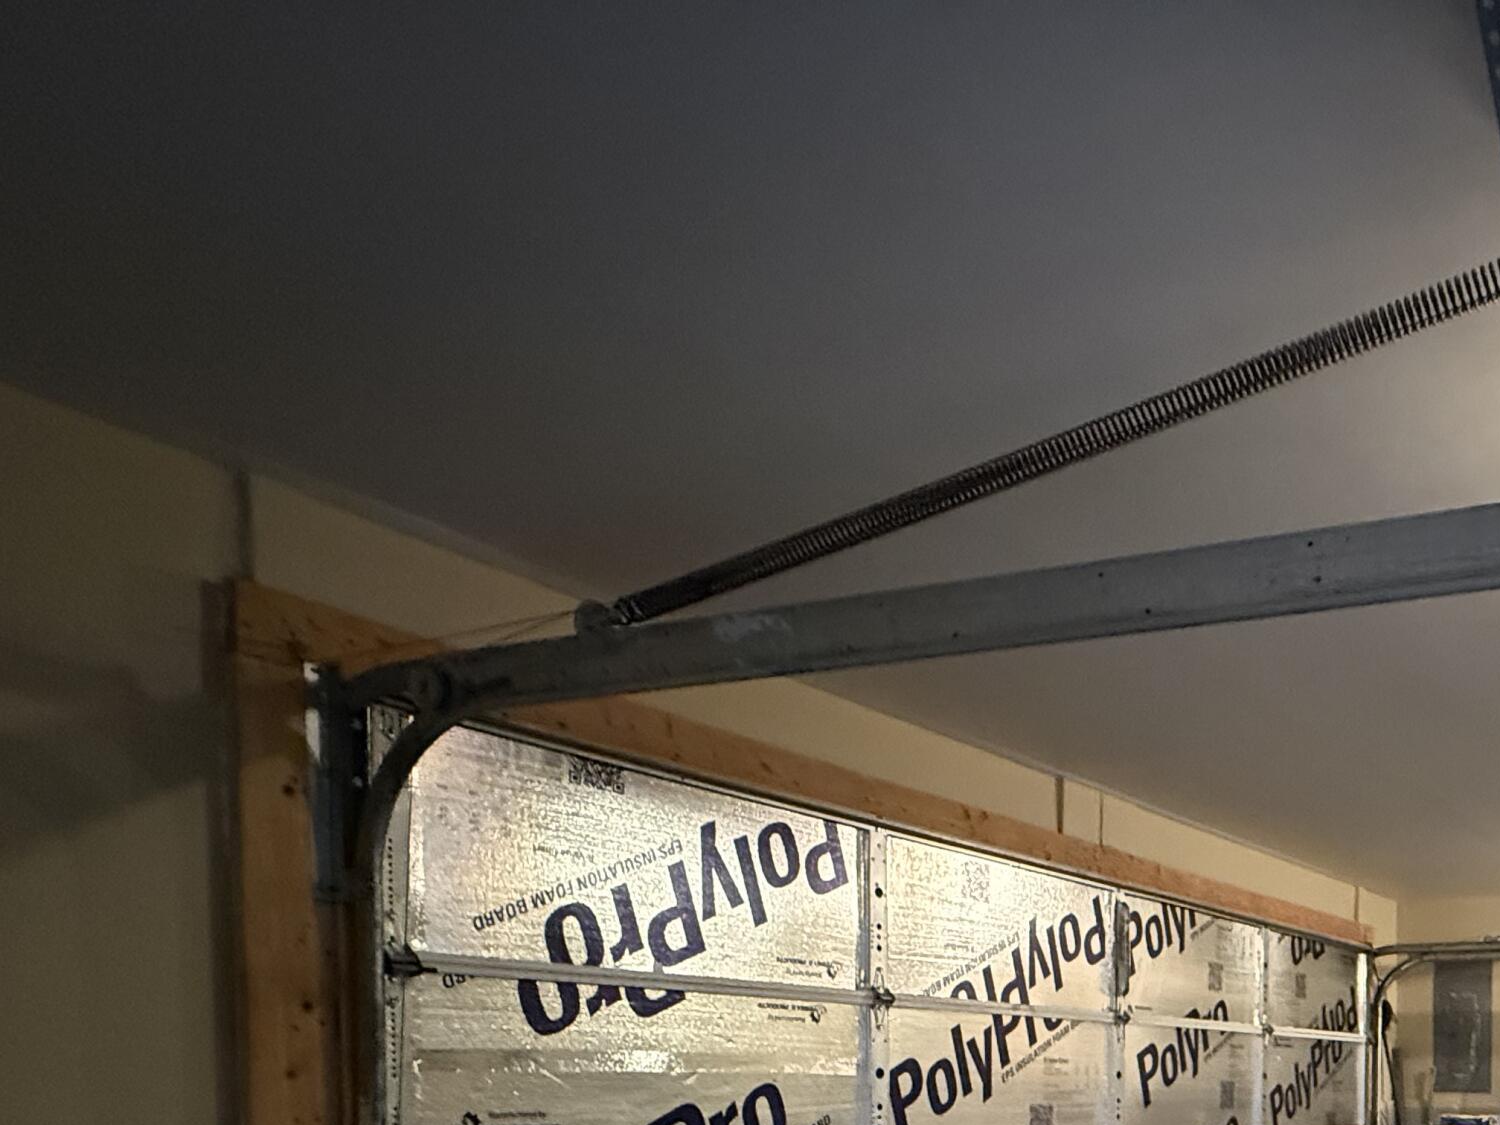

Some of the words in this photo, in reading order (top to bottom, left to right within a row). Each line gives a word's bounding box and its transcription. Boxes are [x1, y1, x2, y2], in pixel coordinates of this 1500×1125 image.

[659, 838, 684, 860] EPS
[577, 847, 658, 892] INSULATION
[532, 880, 573, 909] FOAM
[473, 900, 529, 931] BOARD
